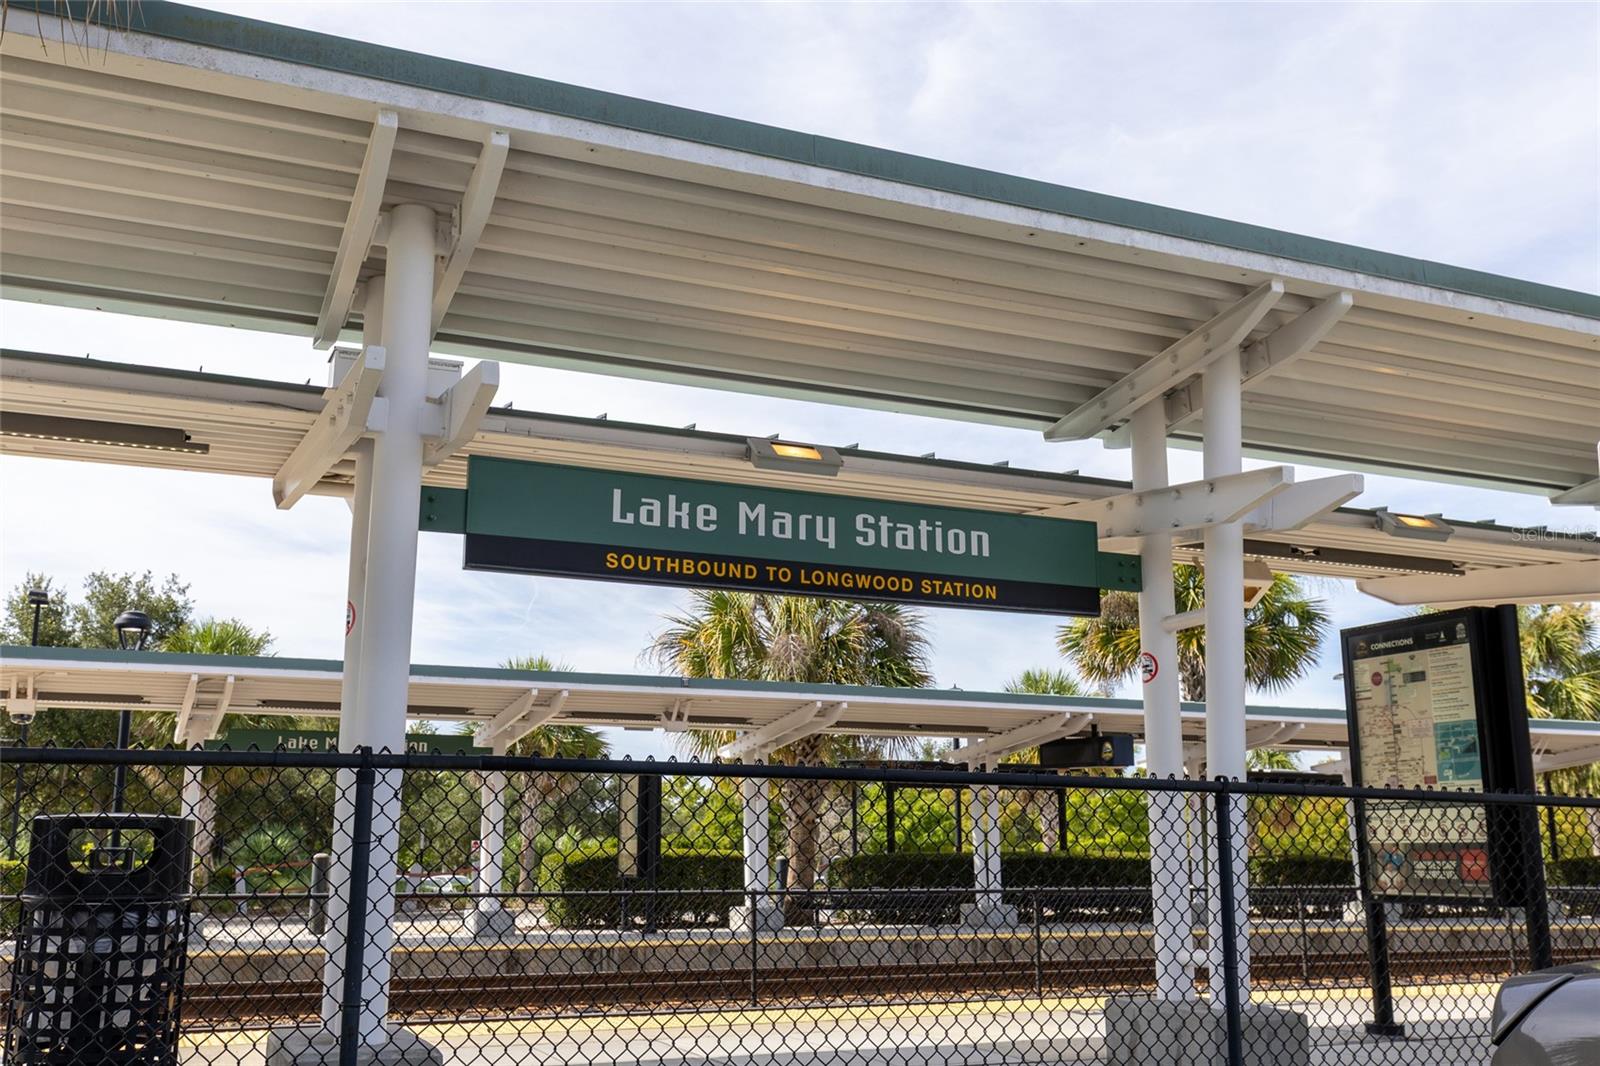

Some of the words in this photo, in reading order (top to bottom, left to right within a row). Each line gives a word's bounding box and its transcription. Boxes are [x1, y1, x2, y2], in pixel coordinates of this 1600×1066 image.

[612, 488, 718, 532] Lake
[738, 501, 836, 549] Mary
[855, 513, 990, 557] Station
[605, 552, 758, 580] SOUTHBOUND
[765, 566, 792, 583] TO
[800, 569, 914, 592] LONGWOOD
[920, 579, 997, 600] STATION
[1370, 637, 1414, 651] CONNECTIONS
[278, 735, 318, 750] Lake
